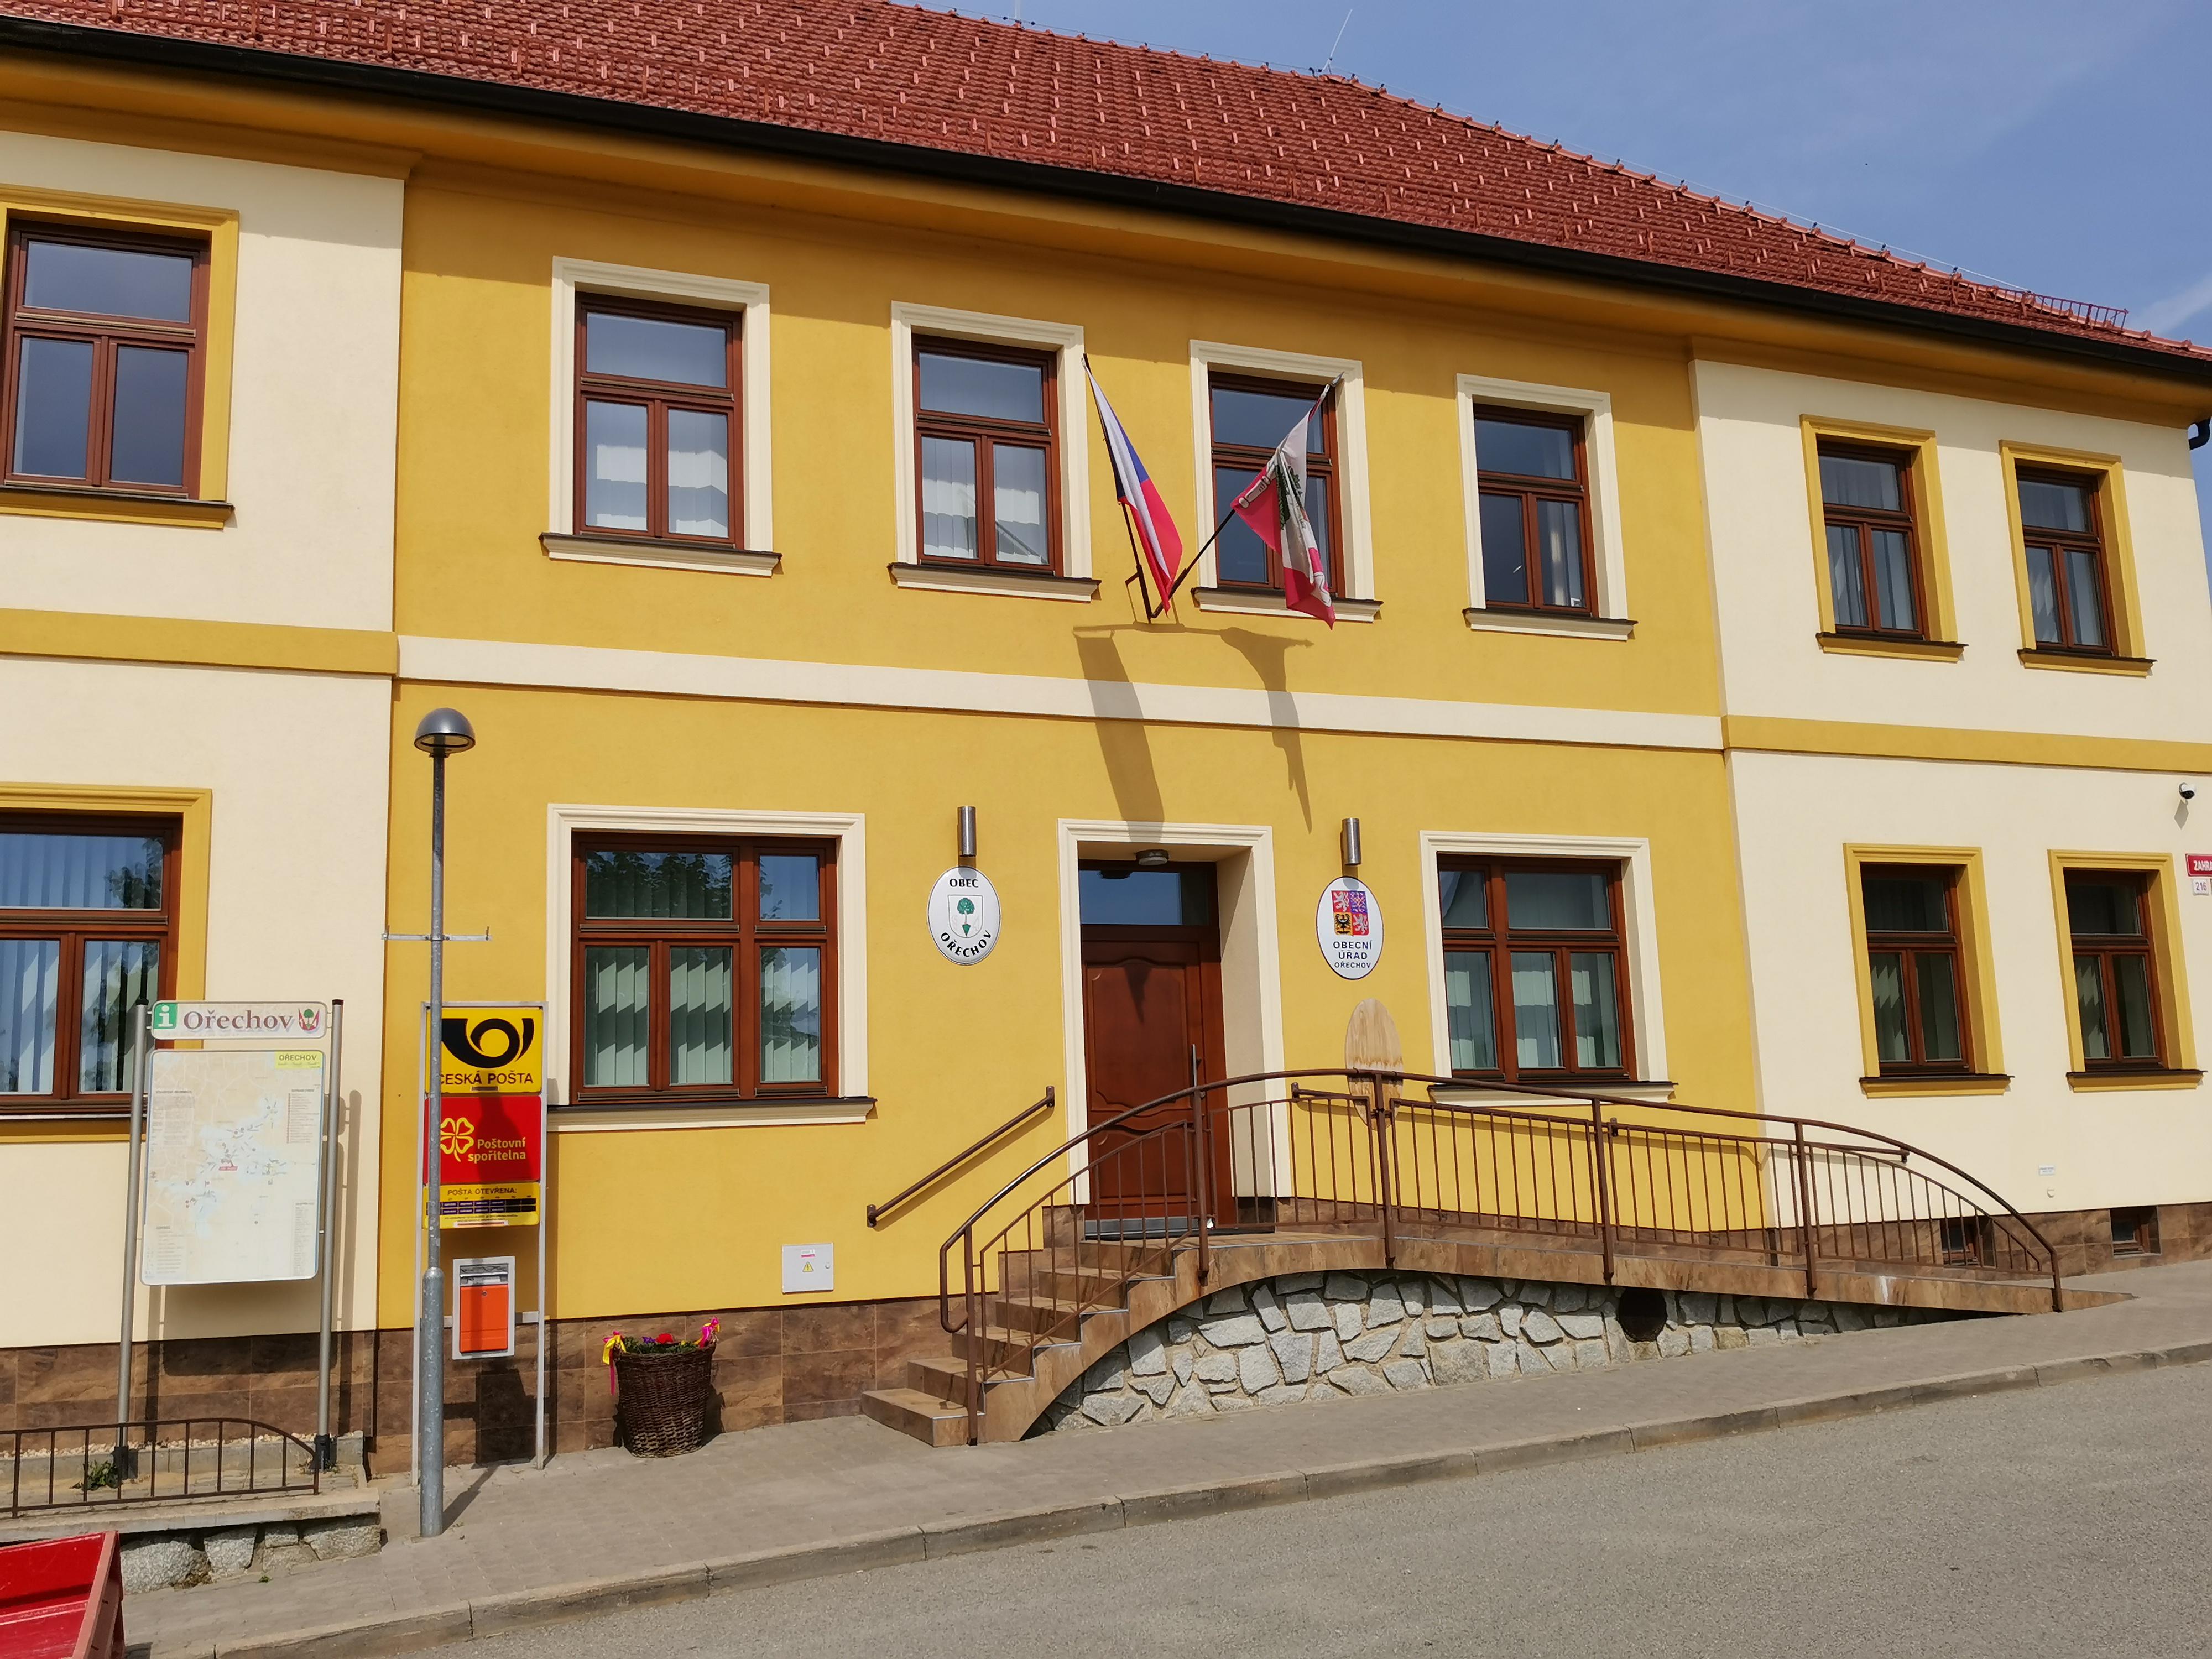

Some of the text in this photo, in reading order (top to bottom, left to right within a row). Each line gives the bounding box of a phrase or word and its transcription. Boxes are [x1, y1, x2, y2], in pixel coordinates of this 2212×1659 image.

[949, 878, 979, 888] OBEC
[2195, 881, 2207, 891] 216
[940, 930, 992, 957] OŘECHOV
[1333, 940, 1373, 950] OBECNÍ
[1338, 949, 1368, 959] ÚŘAD
[183, 1009, 294, 1030] Ořechov
[279, 1053, 317, 1061] OŘECHOV
[487, 1070, 534, 1084] POŠTA
[477, 1137, 526, 1149] Poštovní
[467, 1149, 526, 1164] spořitelna
